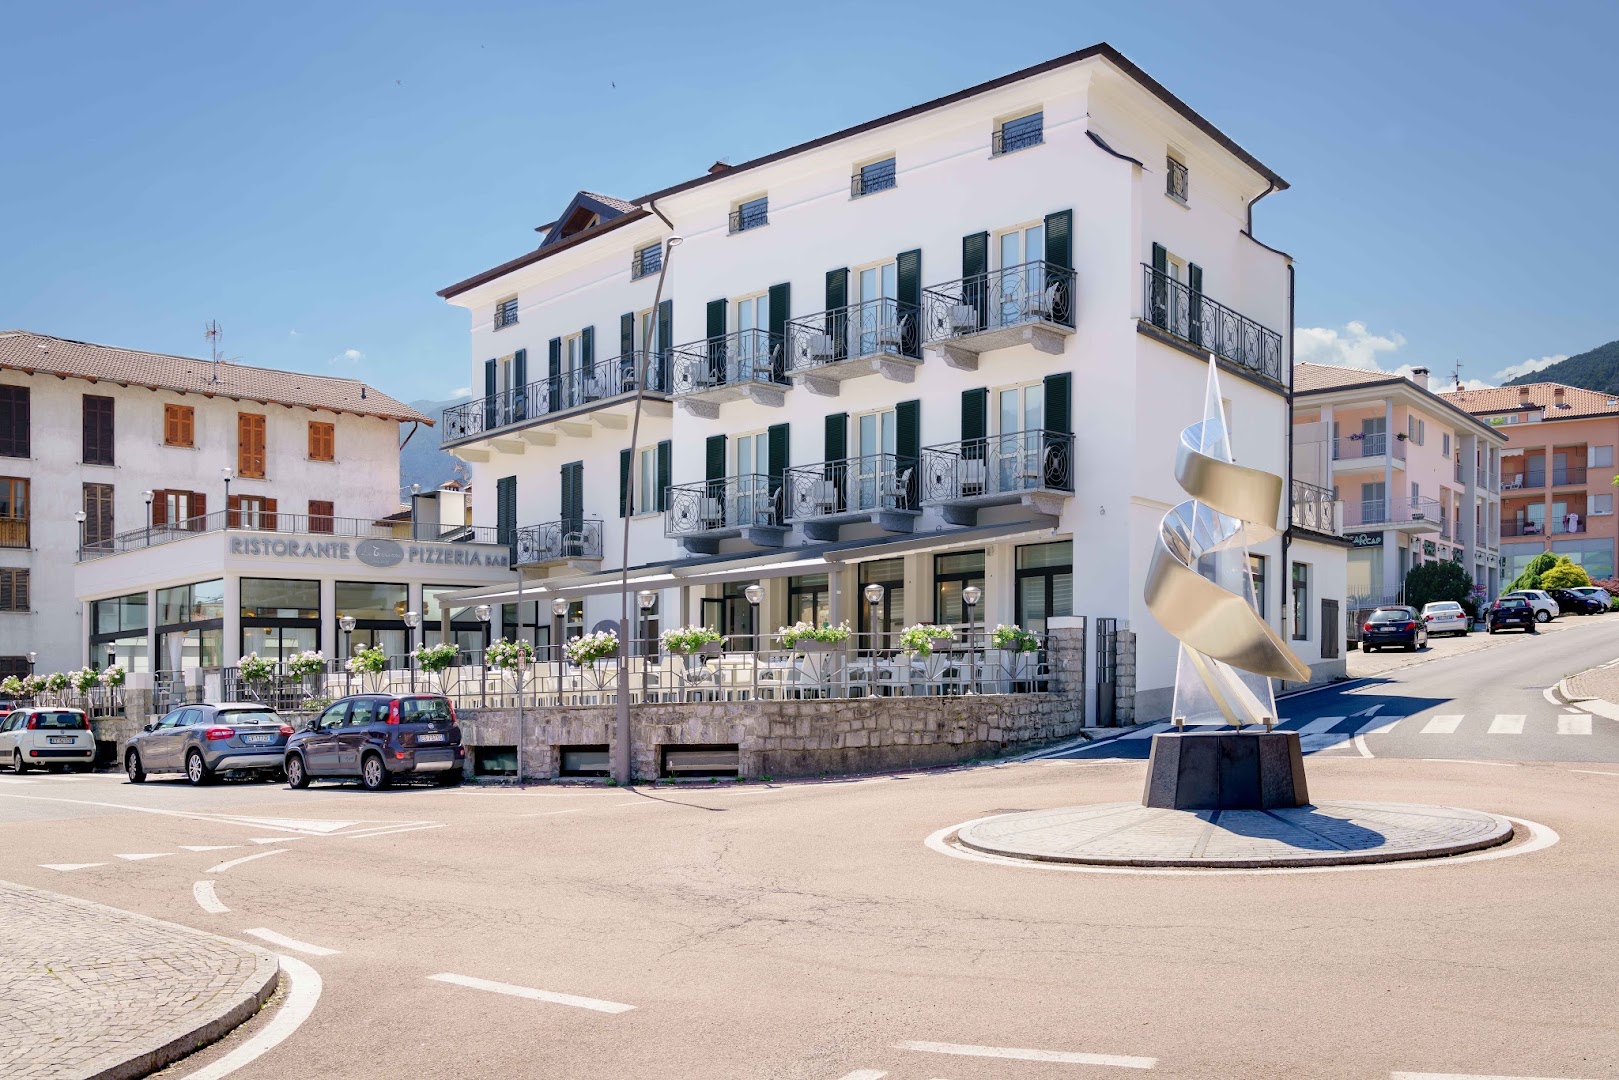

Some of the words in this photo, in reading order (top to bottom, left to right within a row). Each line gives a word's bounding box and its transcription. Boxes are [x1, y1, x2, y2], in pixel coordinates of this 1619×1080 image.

[230, 536, 350, 560] RISTORANTE
[409, 546, 481, 566] PIZZERIA
[485, 554, 508, 567] BAR
